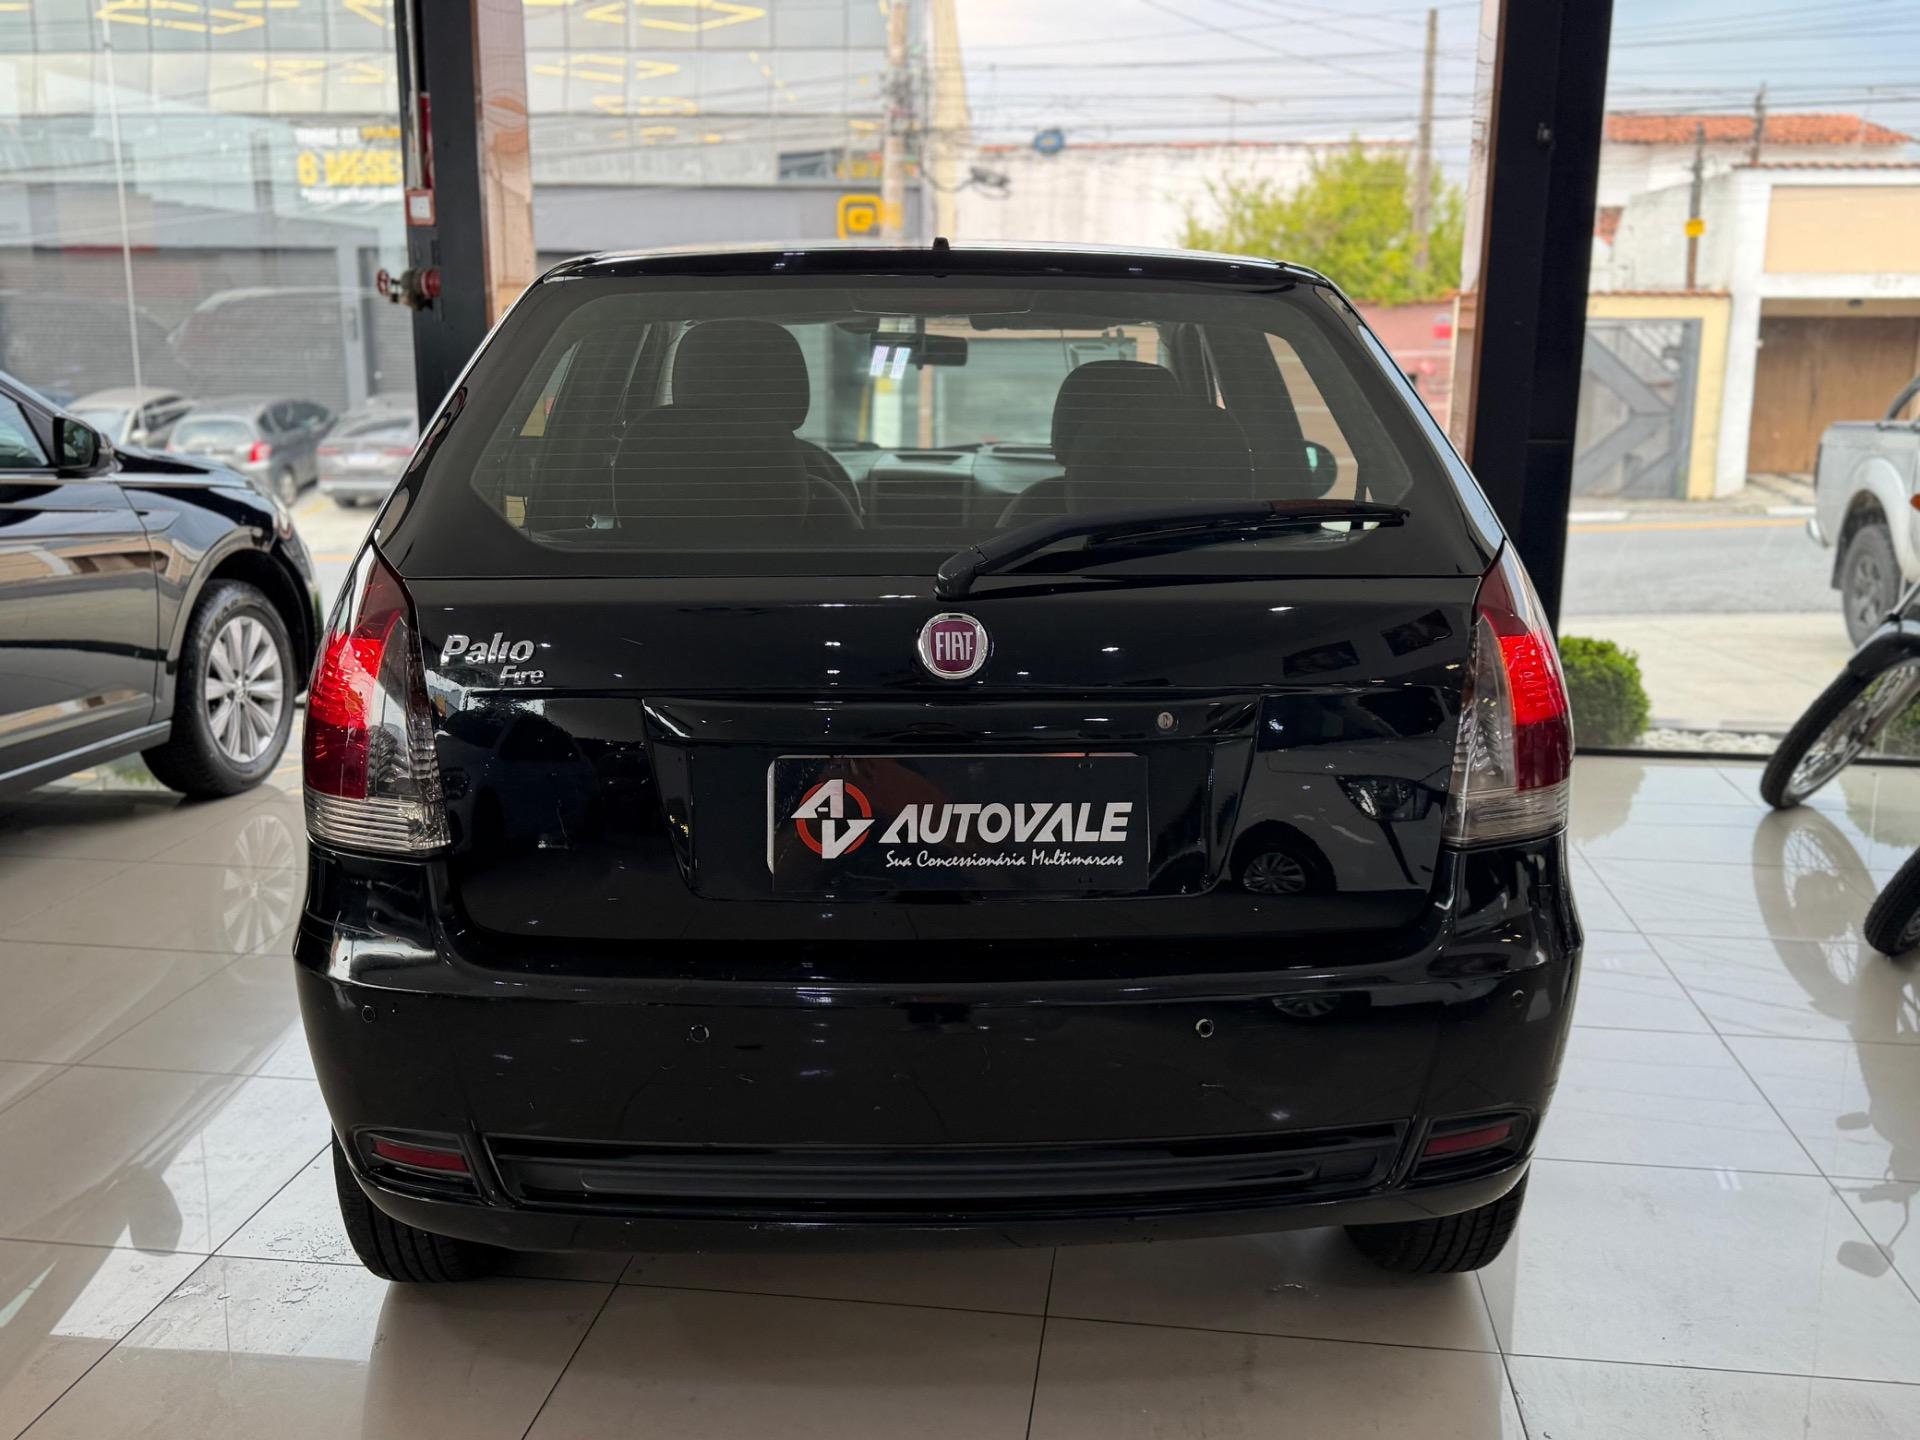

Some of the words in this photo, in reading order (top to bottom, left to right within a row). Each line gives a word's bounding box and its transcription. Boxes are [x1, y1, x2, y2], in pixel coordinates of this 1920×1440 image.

[440, 632, 535, 666] Palio
[935, 631, 974, 661] FIAT
[500, 665, 545, 686] Fire
[878, 802, 1133, 844] AUTOVALE
[885, 849, 912, 868] Sua
[916, 849, 1027, 868] Concessionária
[1030, 848, 1124, 867] Multimarcas
